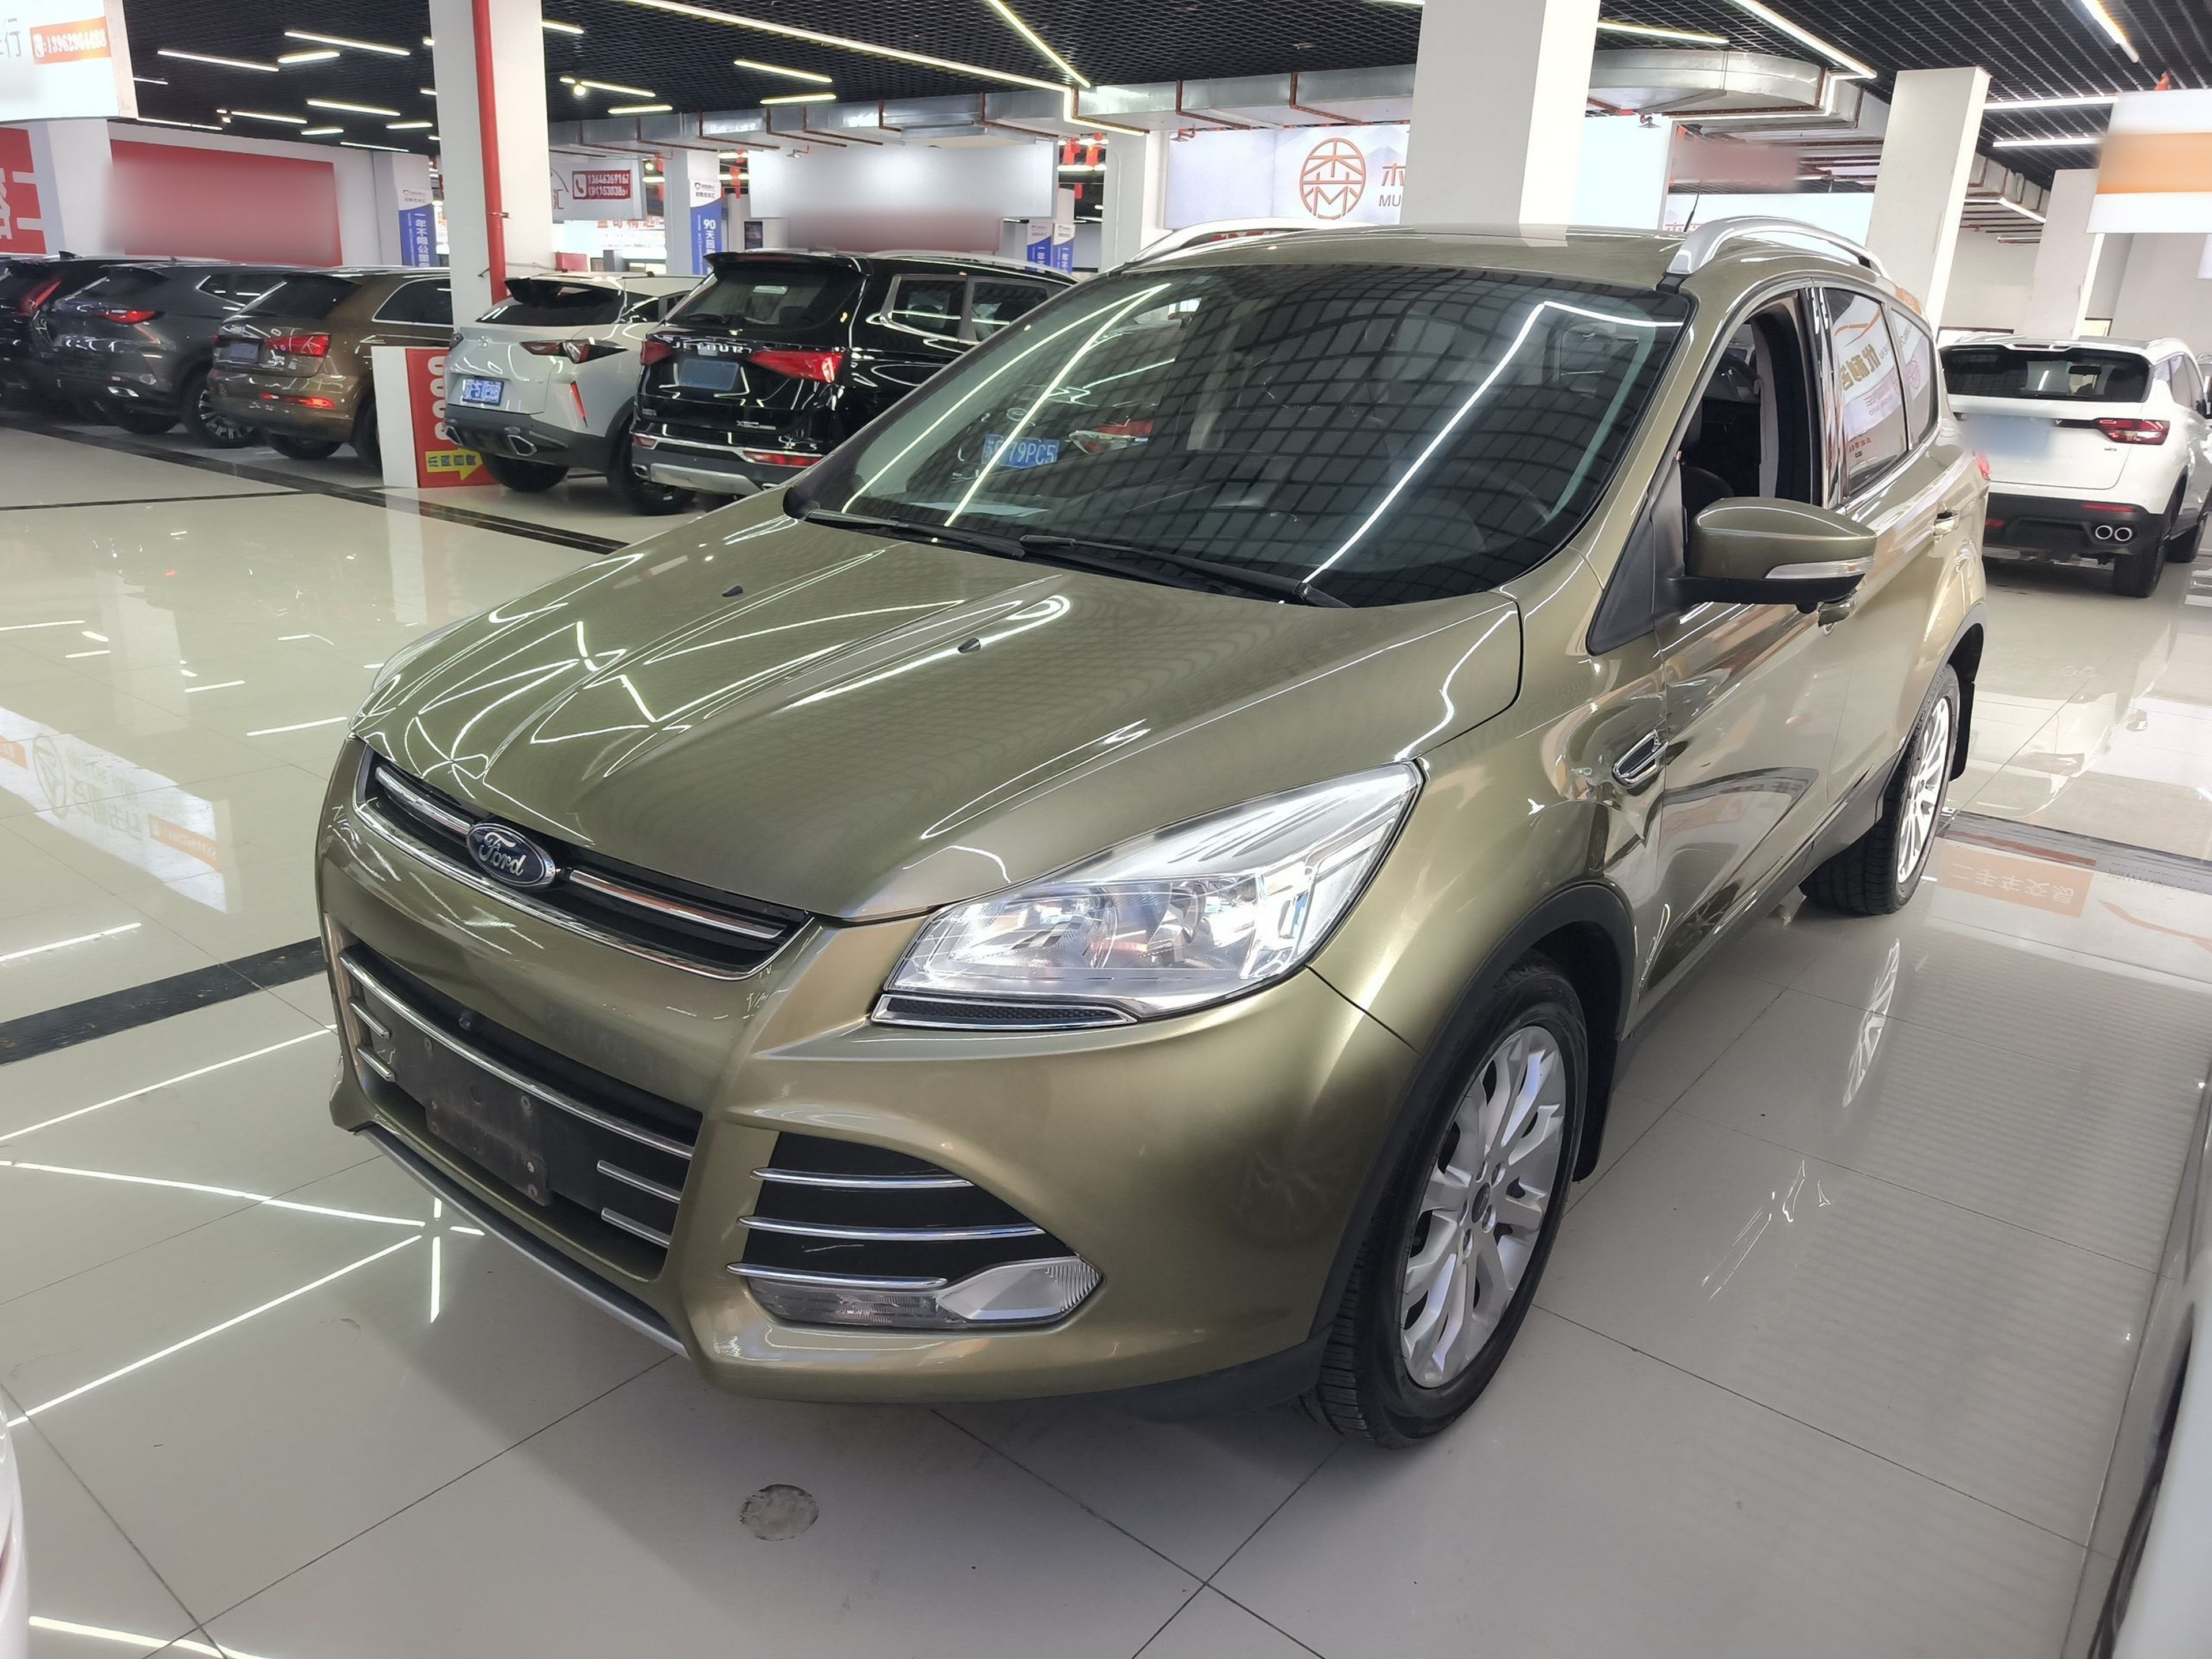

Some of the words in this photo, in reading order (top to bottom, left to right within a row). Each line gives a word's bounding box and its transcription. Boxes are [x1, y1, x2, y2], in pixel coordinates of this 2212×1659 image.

[0, 17, 22, 58] 行
[1378, 194, 1402, 207] MU
[478, 832, 527, 877] Ford
